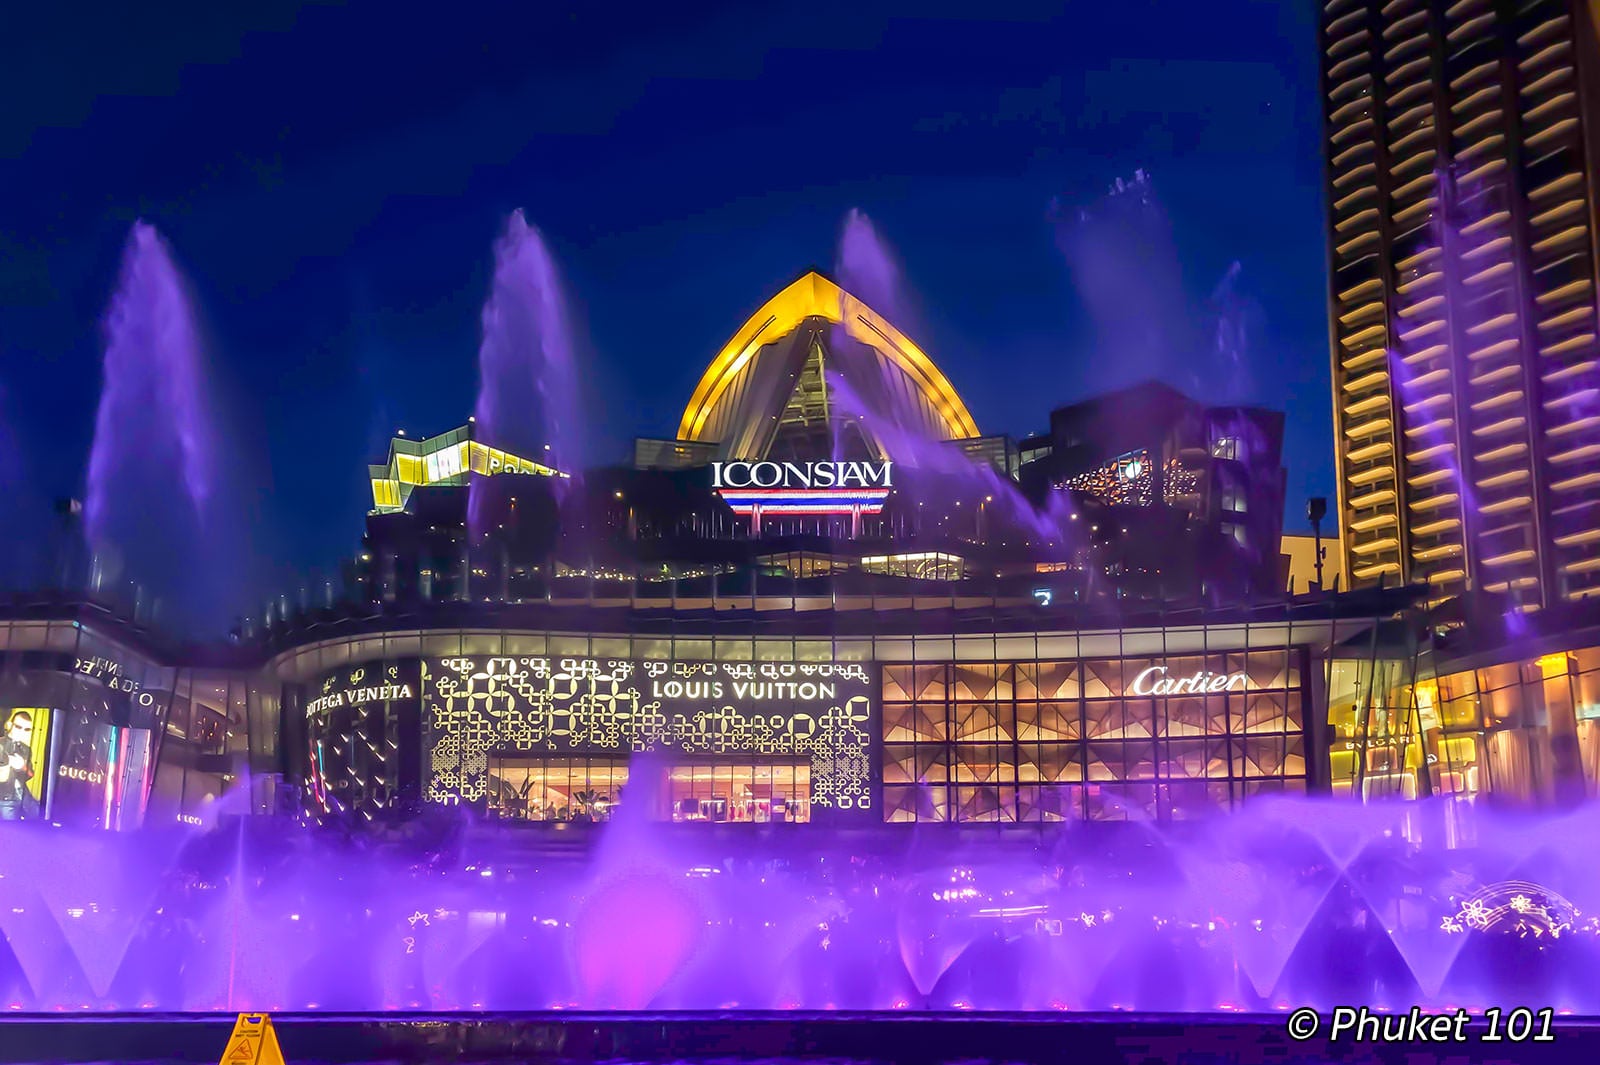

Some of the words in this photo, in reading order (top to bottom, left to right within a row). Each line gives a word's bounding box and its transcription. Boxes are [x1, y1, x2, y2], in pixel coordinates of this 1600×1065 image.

[711, 461, 894, 488] ICONSIAM
[653, 680, 723, 699] LOUIS
[732, 682, 836, 700] VUITTON
[1133, 666, 1248, 695] Cartier
[306, 693, 343, 718] BOTTEGA
[344, 684, 412, 703] VENETA
[59, 765, 102, 784] GUCCI
